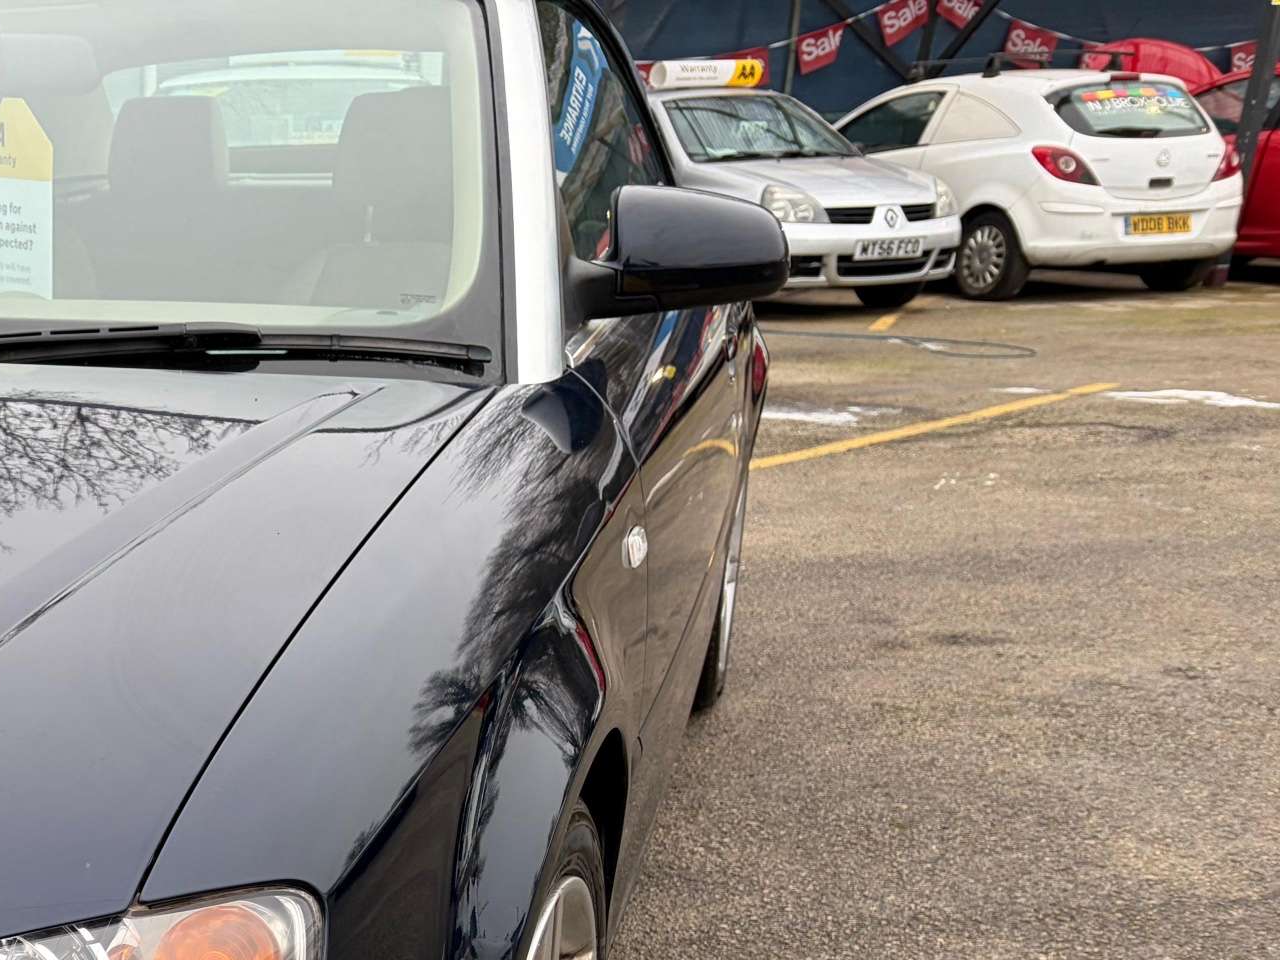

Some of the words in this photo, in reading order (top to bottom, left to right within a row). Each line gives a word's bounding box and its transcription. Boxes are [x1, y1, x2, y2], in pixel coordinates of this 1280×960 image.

[881, 0, 927, 34] Sale
[680, 63, 719, 75] Warranty
[737, 63, 755, 80] AA
[8, 201, 22, 215] for
[5, 221, 37, 234] against
[1167, 214, 1191, 232] BKK
[860, 240, 896, 257] MT56
